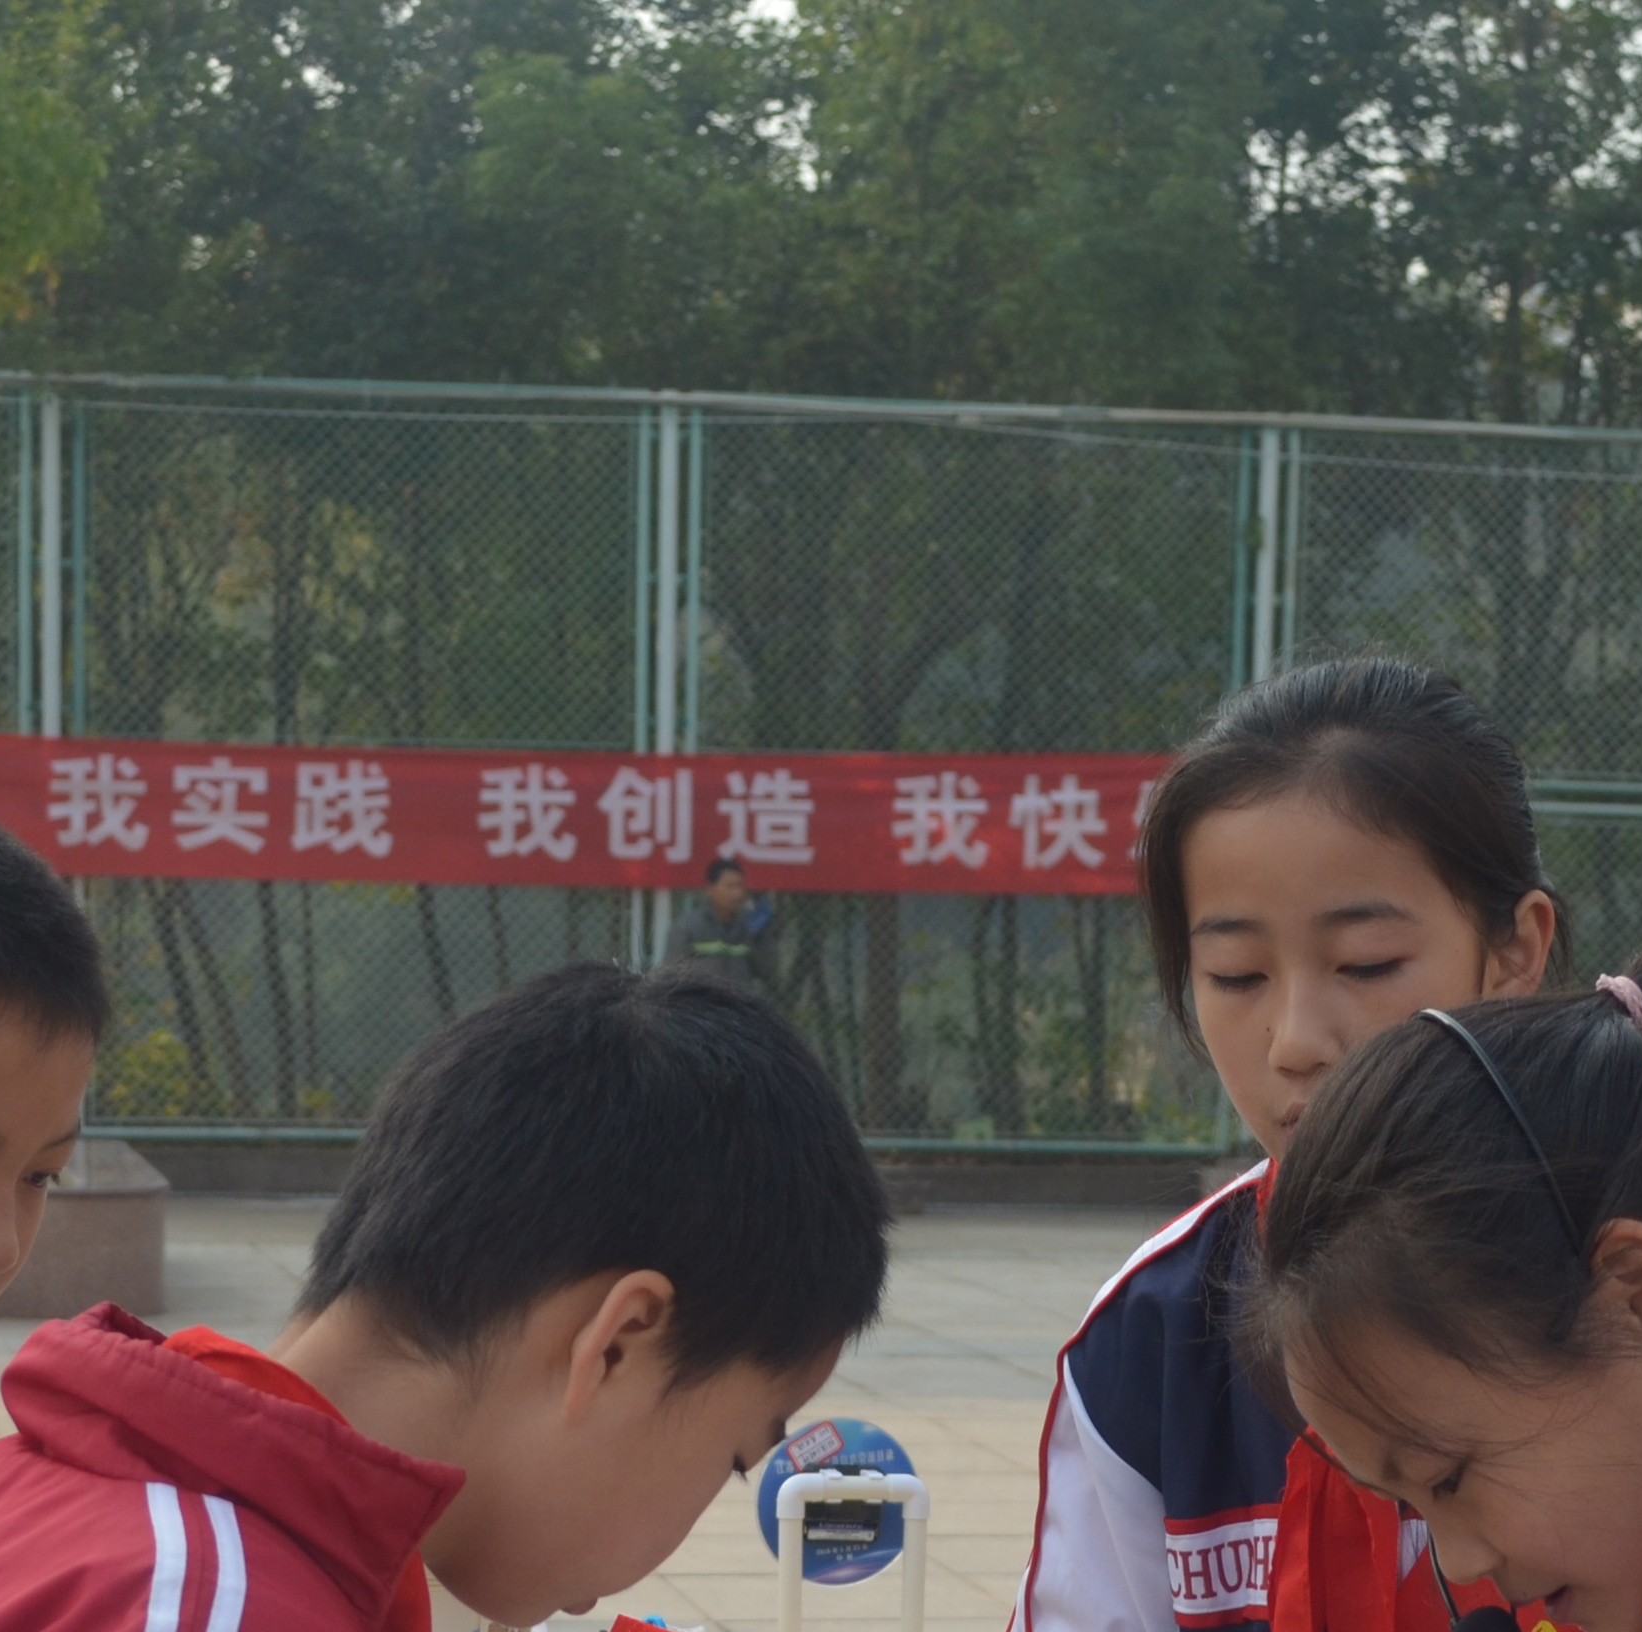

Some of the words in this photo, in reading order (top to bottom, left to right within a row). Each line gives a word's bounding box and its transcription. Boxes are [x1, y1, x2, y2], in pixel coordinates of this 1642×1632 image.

[47, 752, 393, 858] 我实践
[477, 762, 816, 865] 我创造
